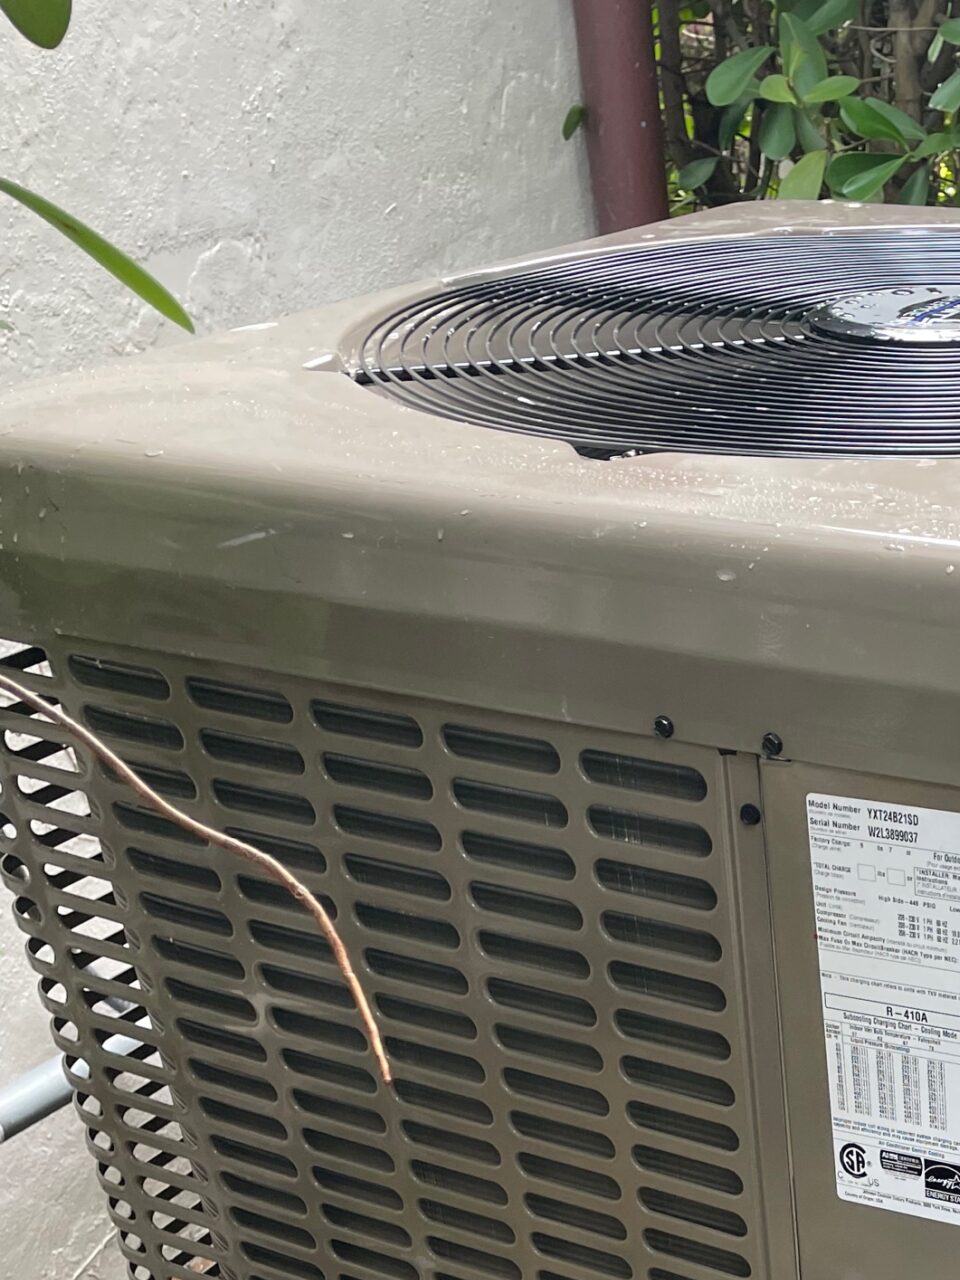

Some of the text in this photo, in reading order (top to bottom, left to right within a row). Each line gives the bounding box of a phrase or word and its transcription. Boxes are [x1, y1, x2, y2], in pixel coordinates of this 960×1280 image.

[807, 799, 830, 810] Model
[832, 802, 861, 814] Number
[866, 807, 918, 826] YXT24B21SD
[809, 817, 830, 827] Serial
[831, 820, 861, 831] Number
[867, 825, 918, 844] W2L3899037
[932, 852, 943, 861] For
[872, 1017, 897, 1029] Charging
